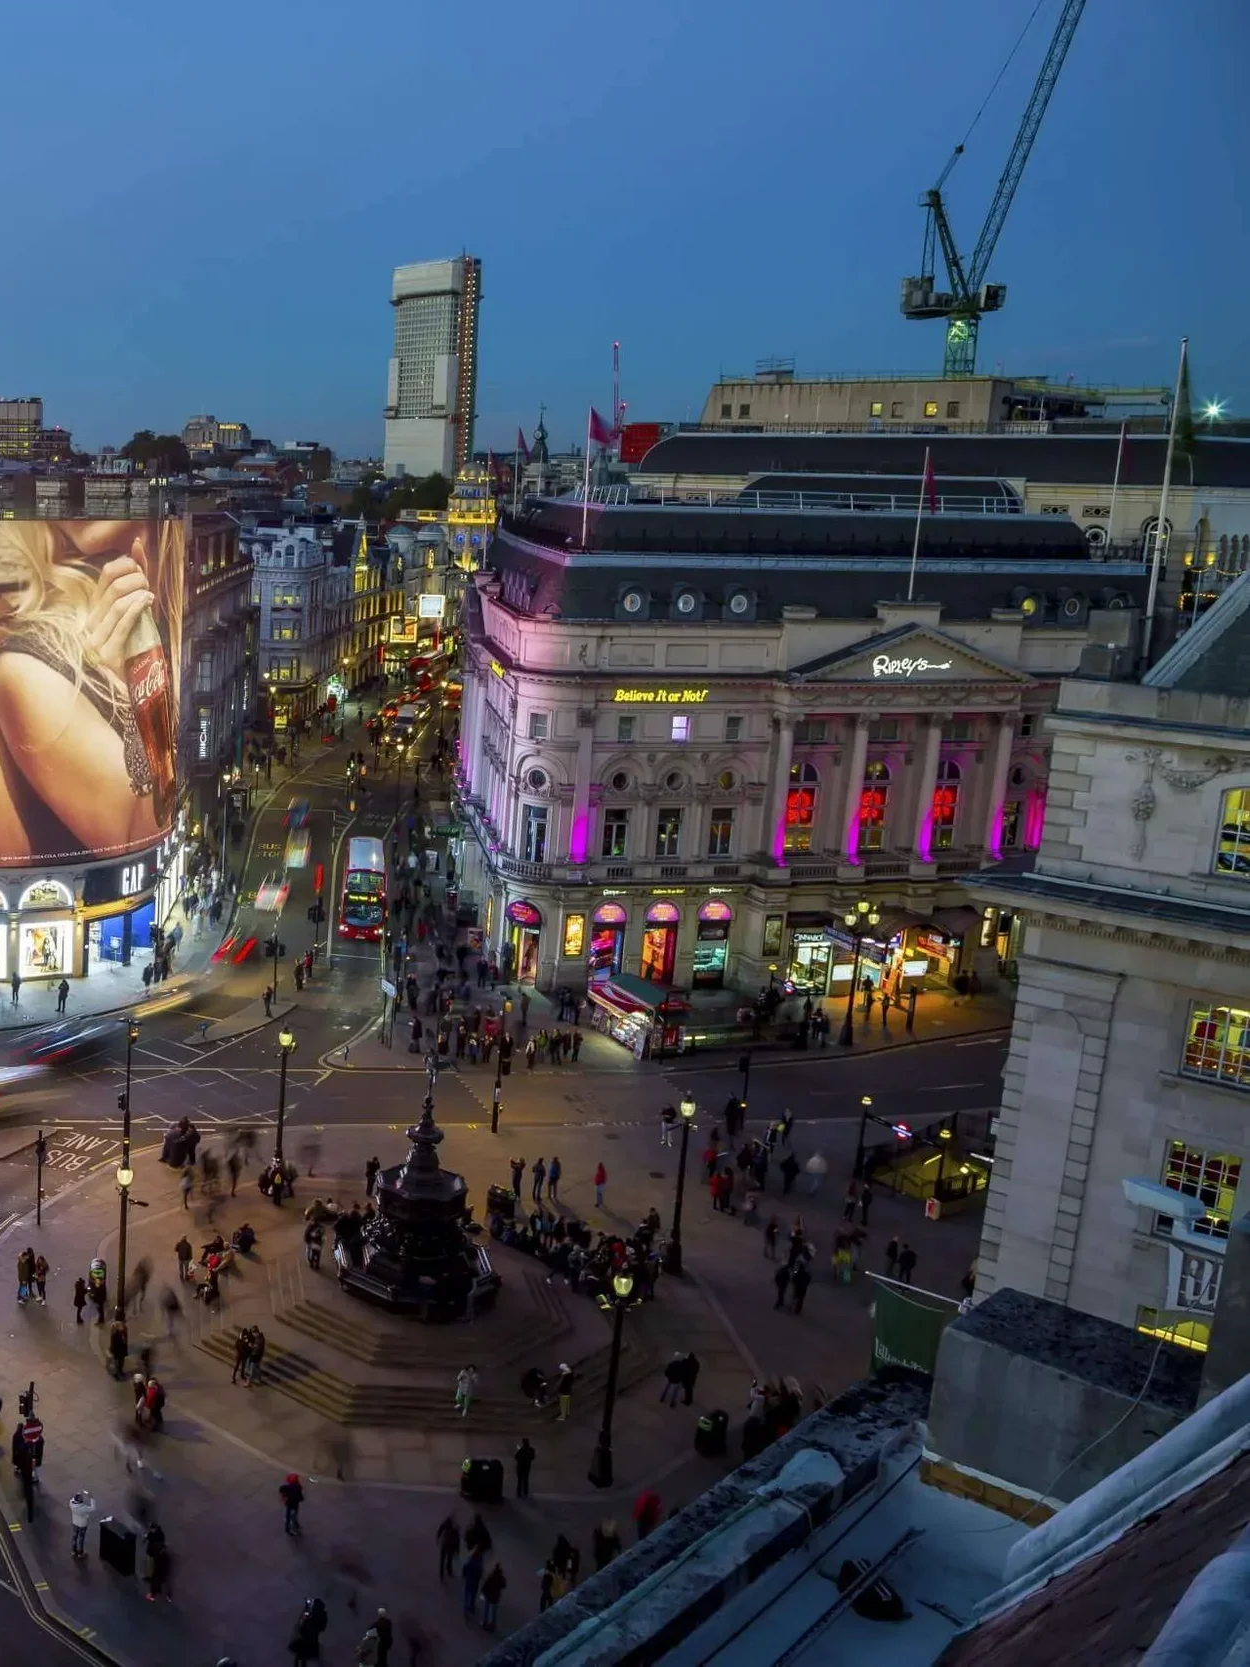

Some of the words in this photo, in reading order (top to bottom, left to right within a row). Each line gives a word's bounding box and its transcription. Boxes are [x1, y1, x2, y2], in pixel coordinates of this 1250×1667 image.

[614, 689, 655, 702] Believe
[656, 689, 667, 702] It
[668, 692, 681, 702] or
[682, 689, 709, 702] Not!
[121, 863, 144, 896] GAP
[53, 1132, 120, 1155] LANE
[45, 1149, 91, 1171] BUS
